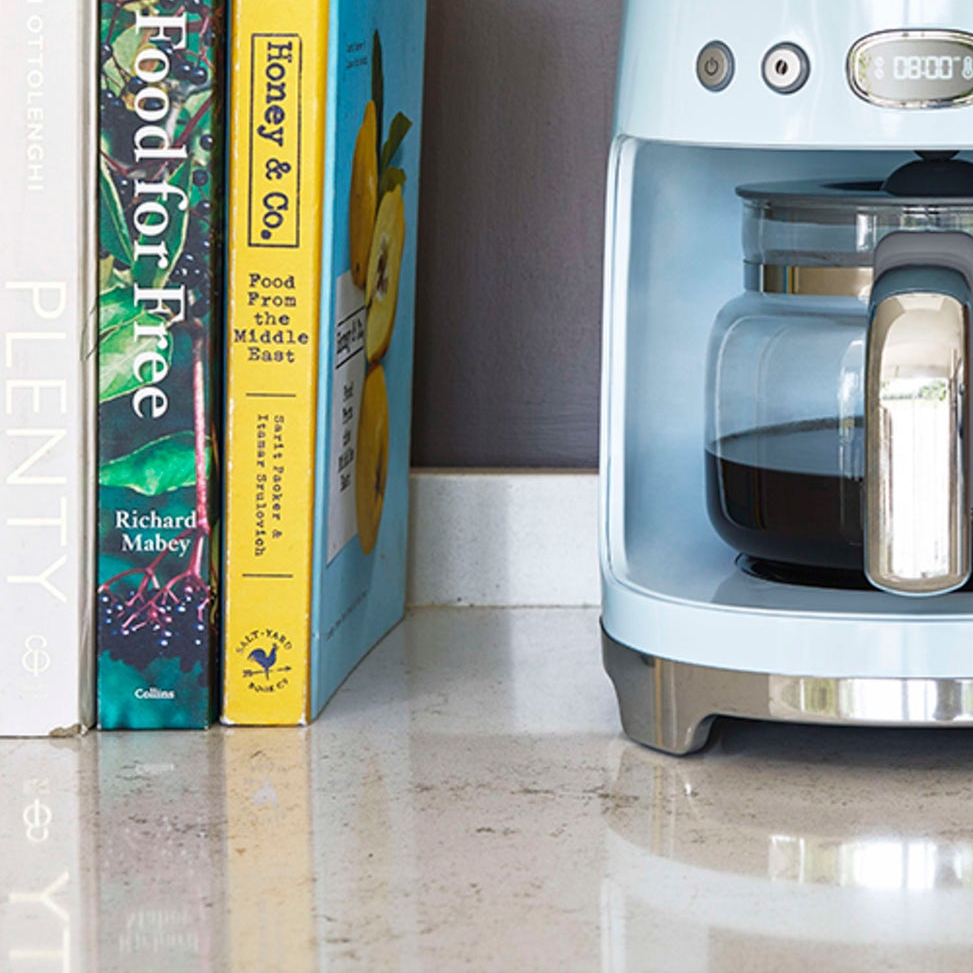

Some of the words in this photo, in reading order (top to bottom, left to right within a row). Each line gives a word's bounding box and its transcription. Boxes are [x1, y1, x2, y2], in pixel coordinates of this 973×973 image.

[134, 10, 187, 162] Food
[894, 56, 953, 80] 08:00
[26, 15, 45, 191] OTTOLENGHI
[257, 41, 292, 147] Honey
[265, 158, 291, 180] &
[133, 179, 188, 269] for
[260, 192, 289, 240] Co.
[247, 291, 297, 307] From
[249, 273, 295, 289] Food
[234, 329, 309, 345] Middle
[253, 311, 290, 326] the
[132, 283, 185, 418] Free
[247, 346, 295, 363] East
[6, 281, 68, 603] PLENTY
[256, 414, 269, 467] Itamar
[272, 415, 285, 459] Sarit
[272, 465, 285, 521] Packer
[115, 509, 197, 529] Richard
[255, 474, 268, 557] Srulovich
[121, 533, 192, 558] Mabey
[134, 687, 175, 699] Collins
